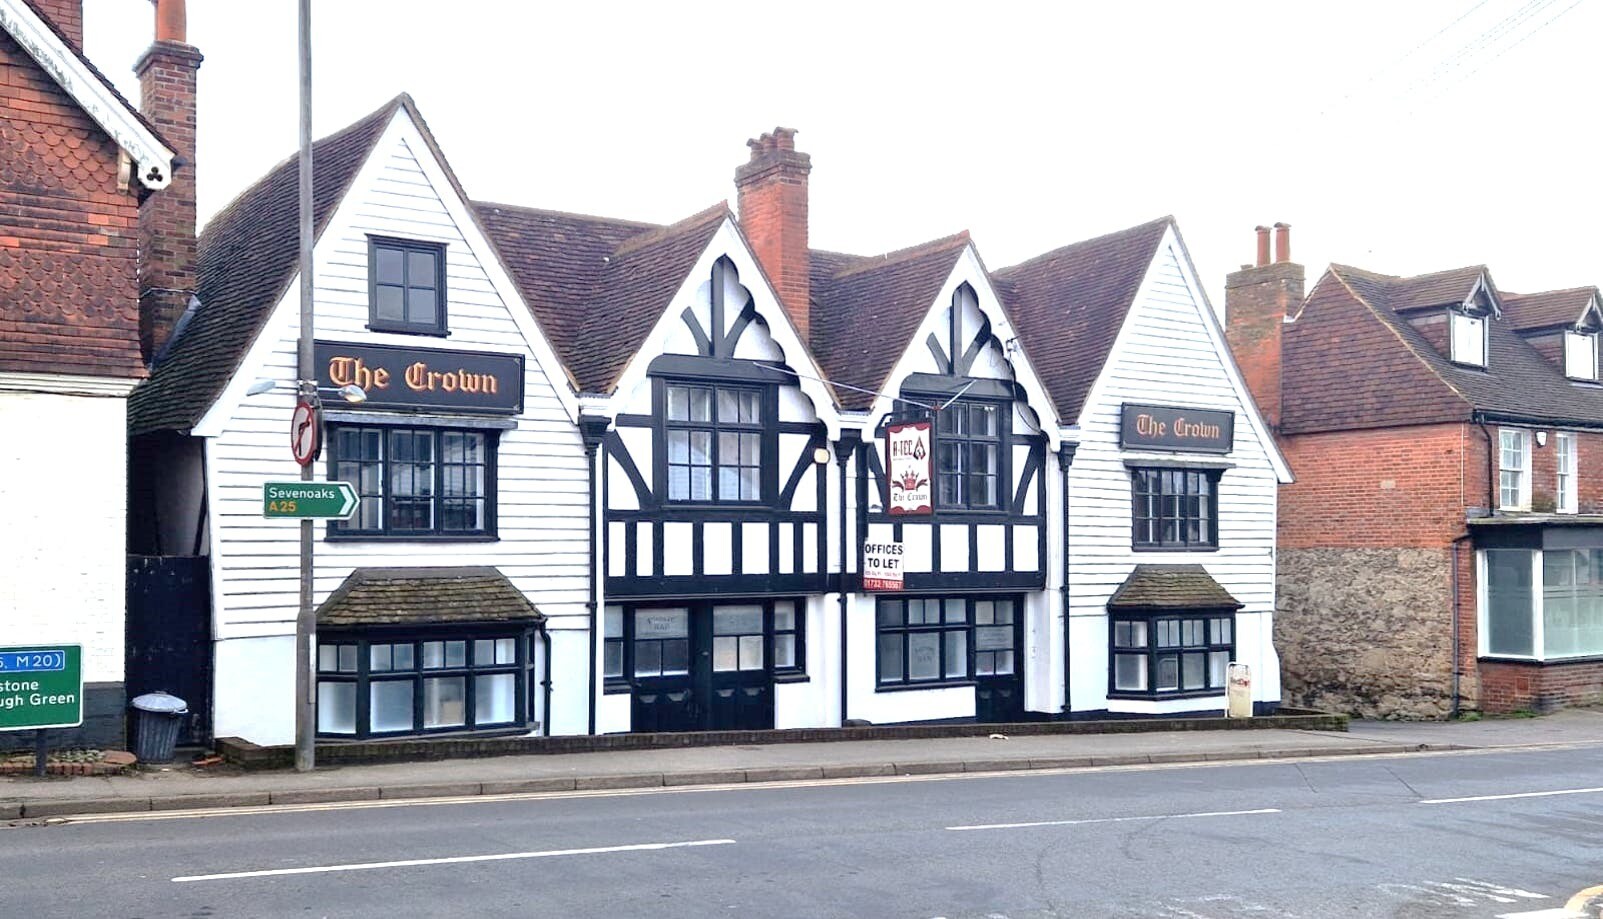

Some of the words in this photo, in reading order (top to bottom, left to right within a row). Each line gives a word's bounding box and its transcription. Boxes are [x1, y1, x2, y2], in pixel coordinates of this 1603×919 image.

[328, 356, 390, 392] The
[405, 361, 499, 394] Crown
[1136, 414, 1166, 438] The
[1173, 417, 1220, 439] Crown
[269, 487, 335, 499] Sevenoaks
[864, 543, 904, 555] OFFICES
[867, 557, 880, 568] TO
[883, 558, 900, 569] LET
[30, 693, 75, 705] Green
